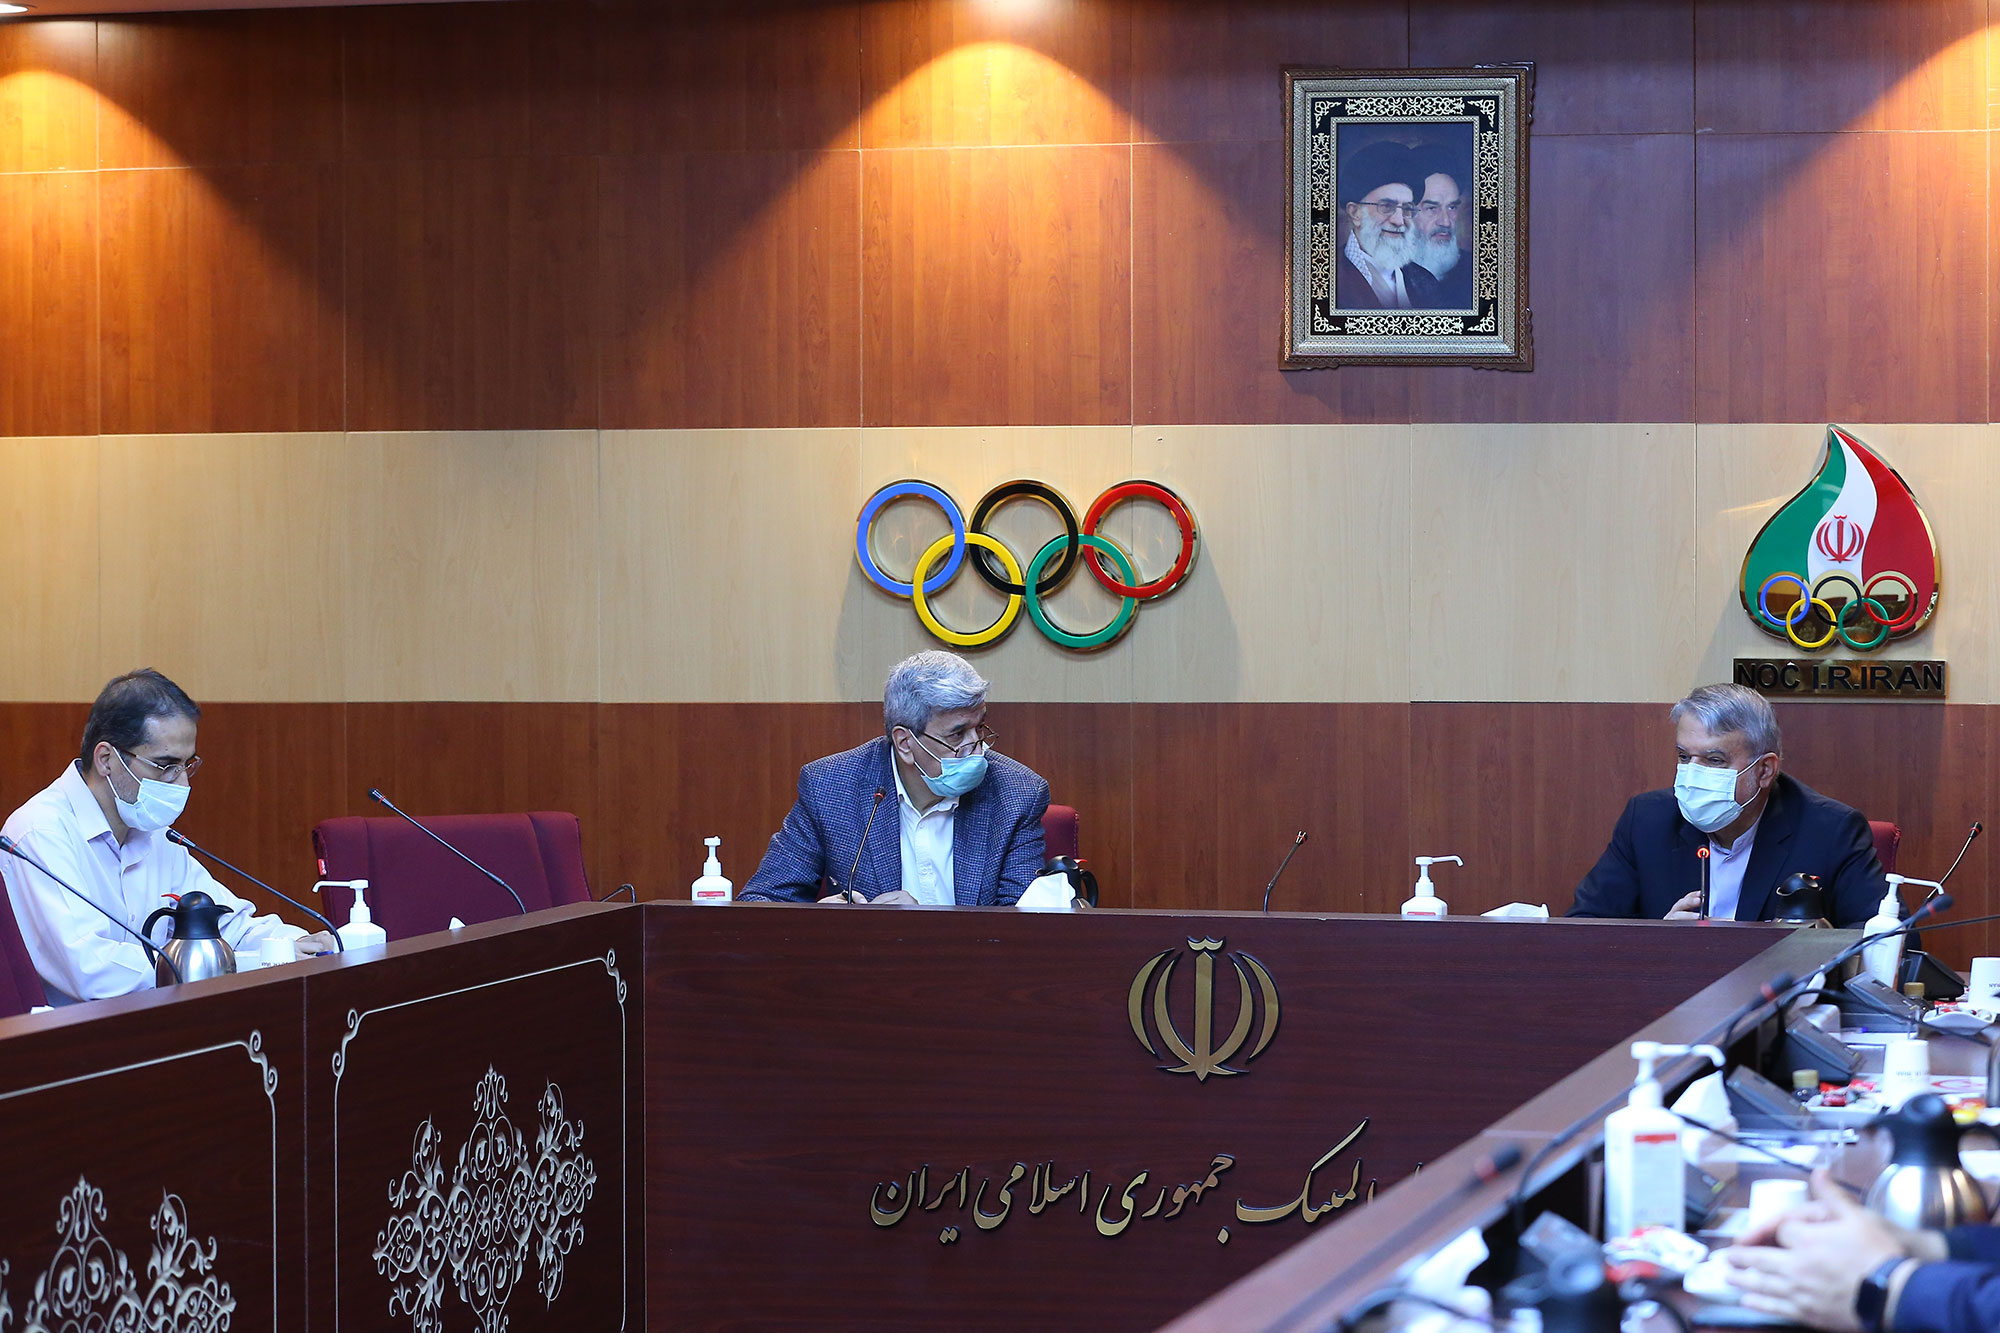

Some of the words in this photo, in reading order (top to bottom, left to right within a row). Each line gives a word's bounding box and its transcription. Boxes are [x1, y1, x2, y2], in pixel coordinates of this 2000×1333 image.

[1737, 663, 1800, 690] NOC
[869, 1164, 969, 1244] ایران
[972, 1160, 1091, 1229] اسلامی
[1095, 1153, 1236, 1244] جمهوری
